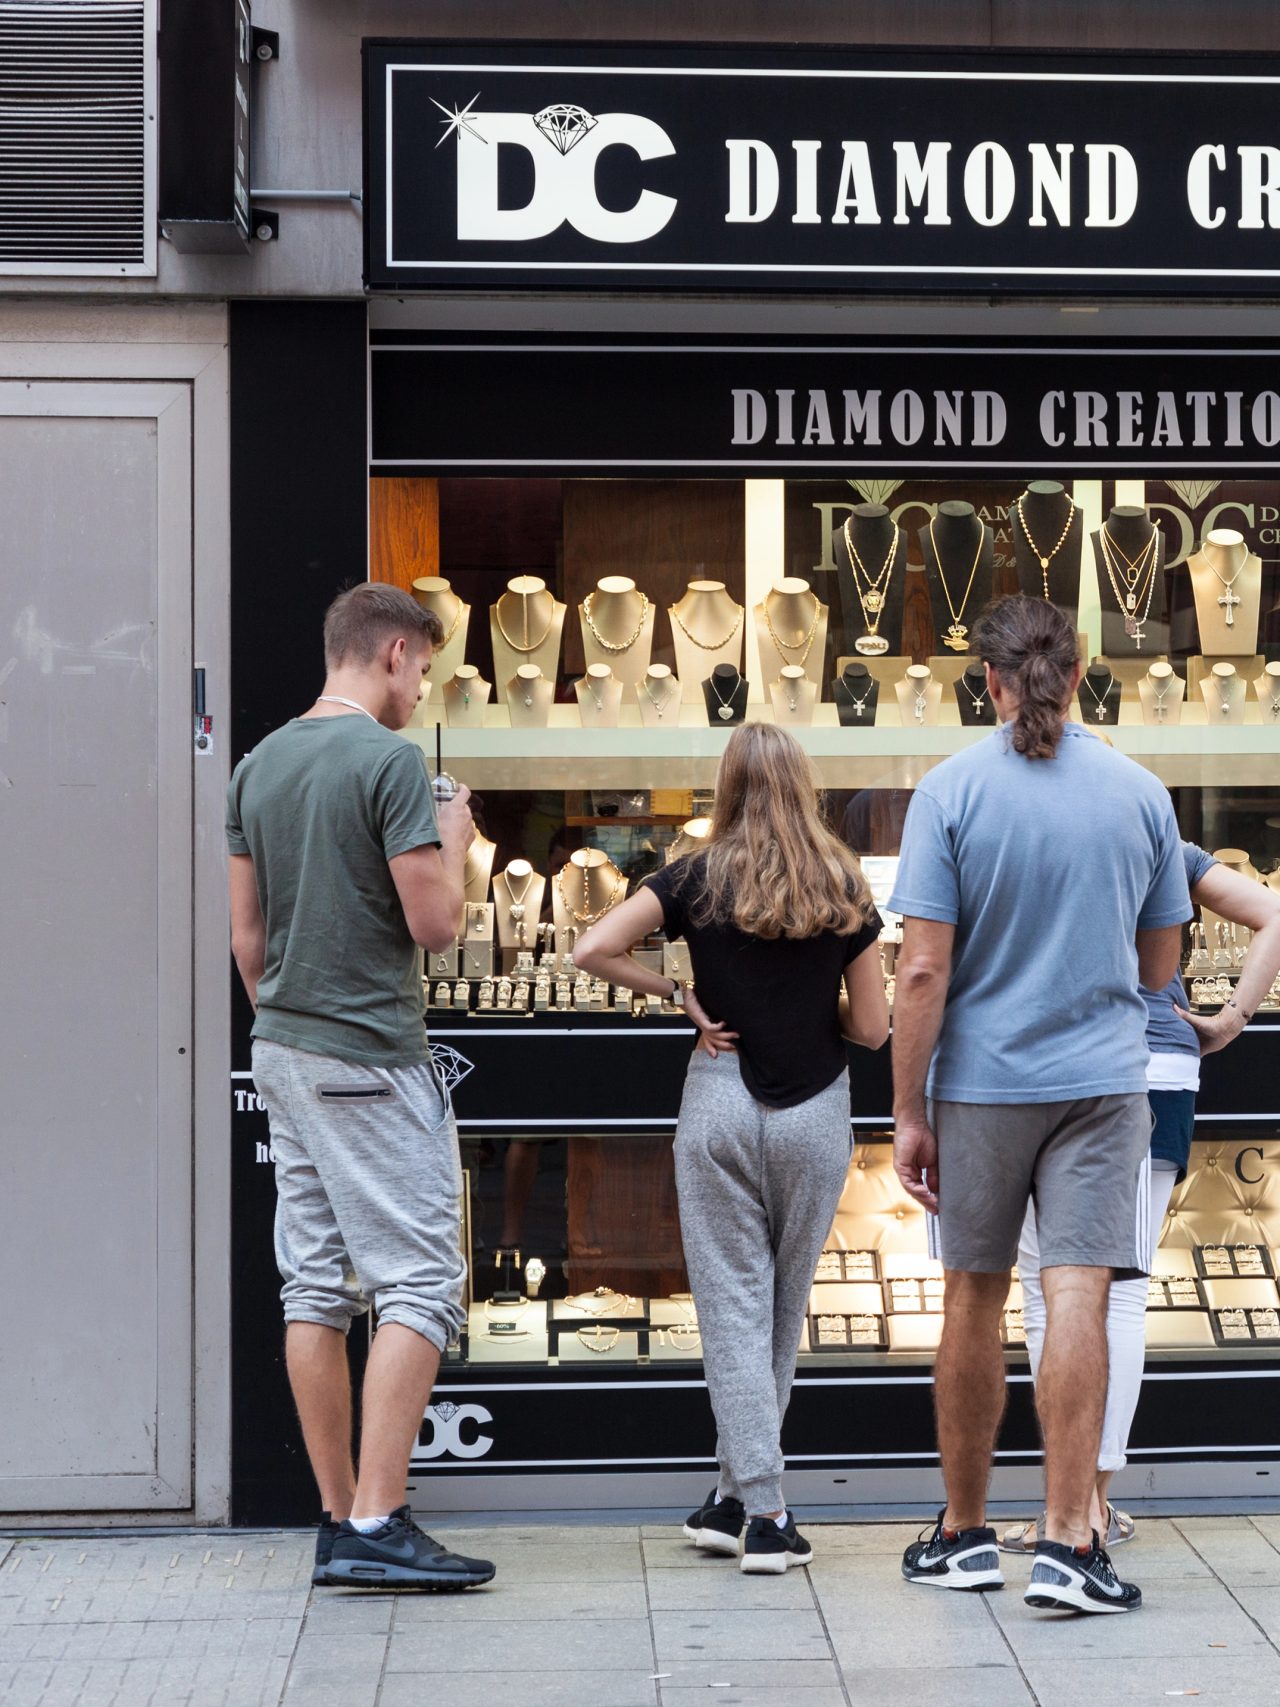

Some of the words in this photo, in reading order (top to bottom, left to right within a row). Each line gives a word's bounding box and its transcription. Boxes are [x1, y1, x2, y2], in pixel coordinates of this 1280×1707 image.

[457, 110, 678, 244] DC
[724, 139, 1139, 228] DIAMOND
[730, 388, 1007, 447] DIAMOND
[1234, 1146, 1265, 1185] C
